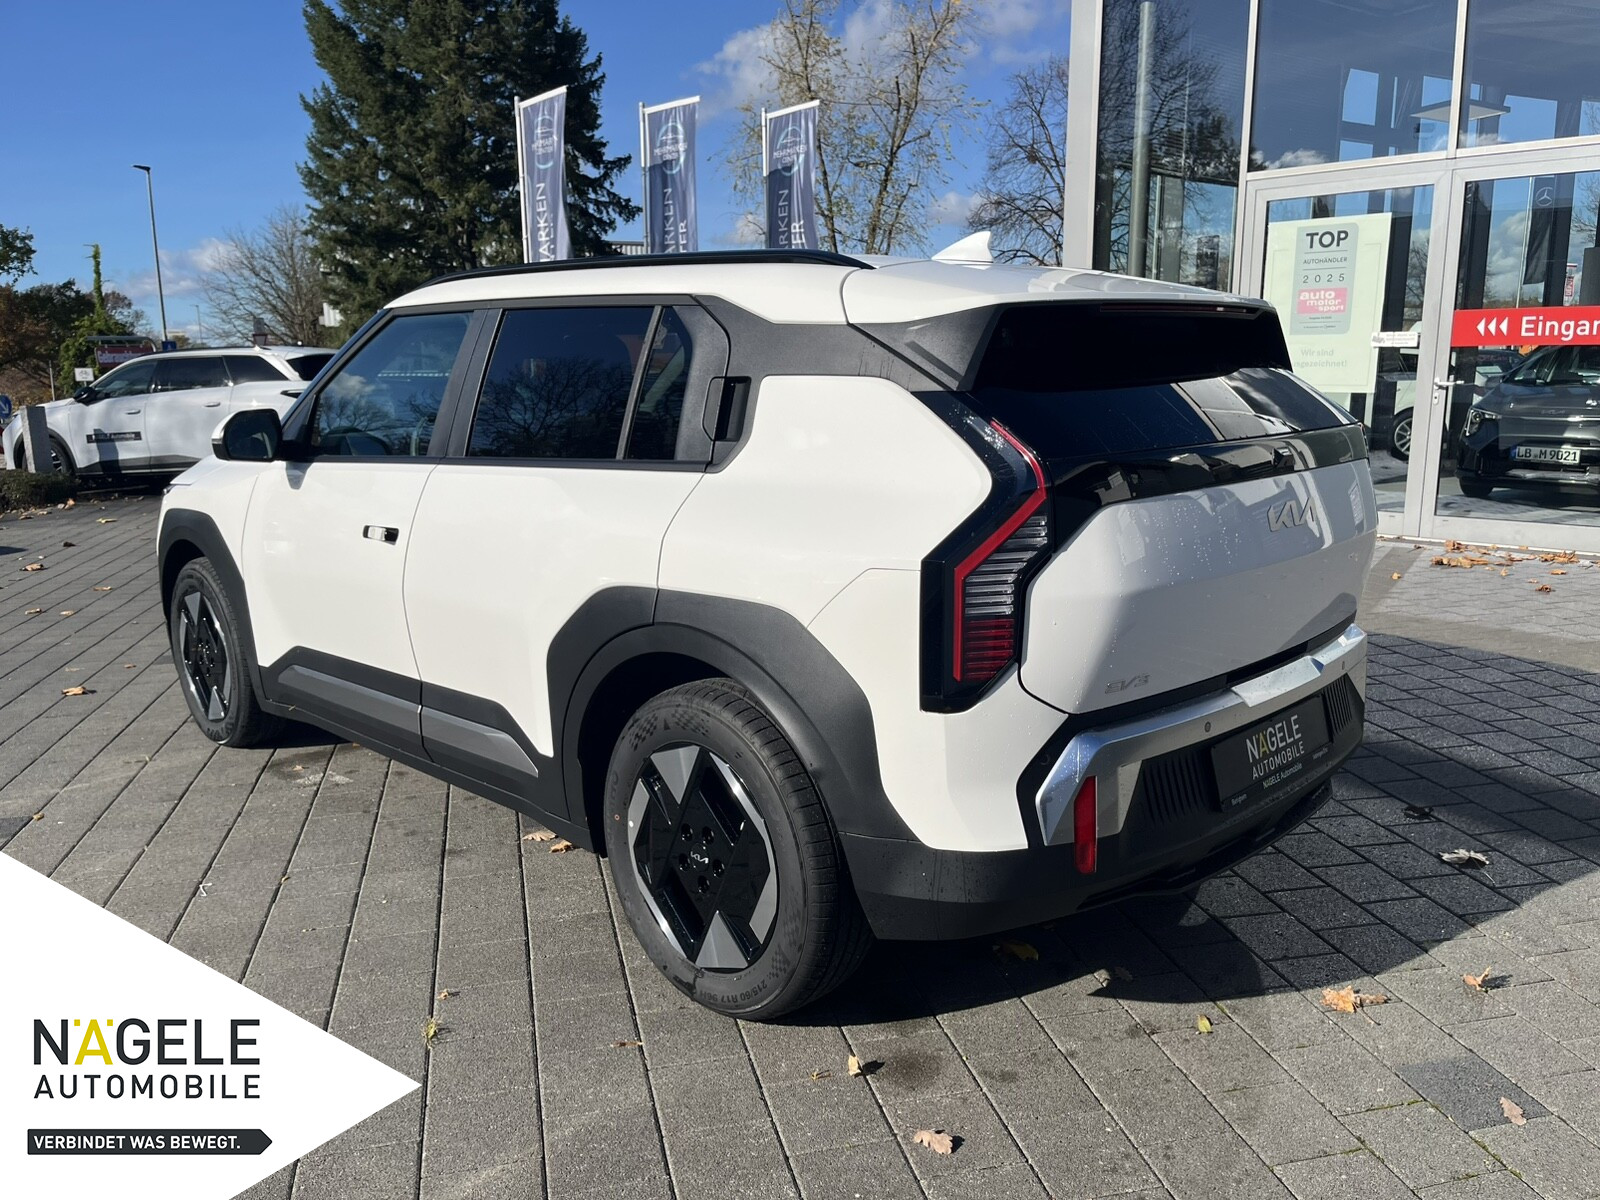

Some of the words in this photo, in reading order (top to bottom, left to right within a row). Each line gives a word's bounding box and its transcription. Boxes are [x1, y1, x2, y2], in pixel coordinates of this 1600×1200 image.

[778, 189, 789, 249] RKEN
[1305, 230, 1349, 249] TOP
[1299, 290, 1336, 300] auto
[1318, 304, 1345, 312] sport
[1517, 447, 1532, 458] LB
[1549, 449, 1578, 462] 9021
[1246, 714, 1302, 763] NÄGELE
[1252, 740, 1305, 780] AUTOMOBILE
[721, 994, 738, 1003] R17
